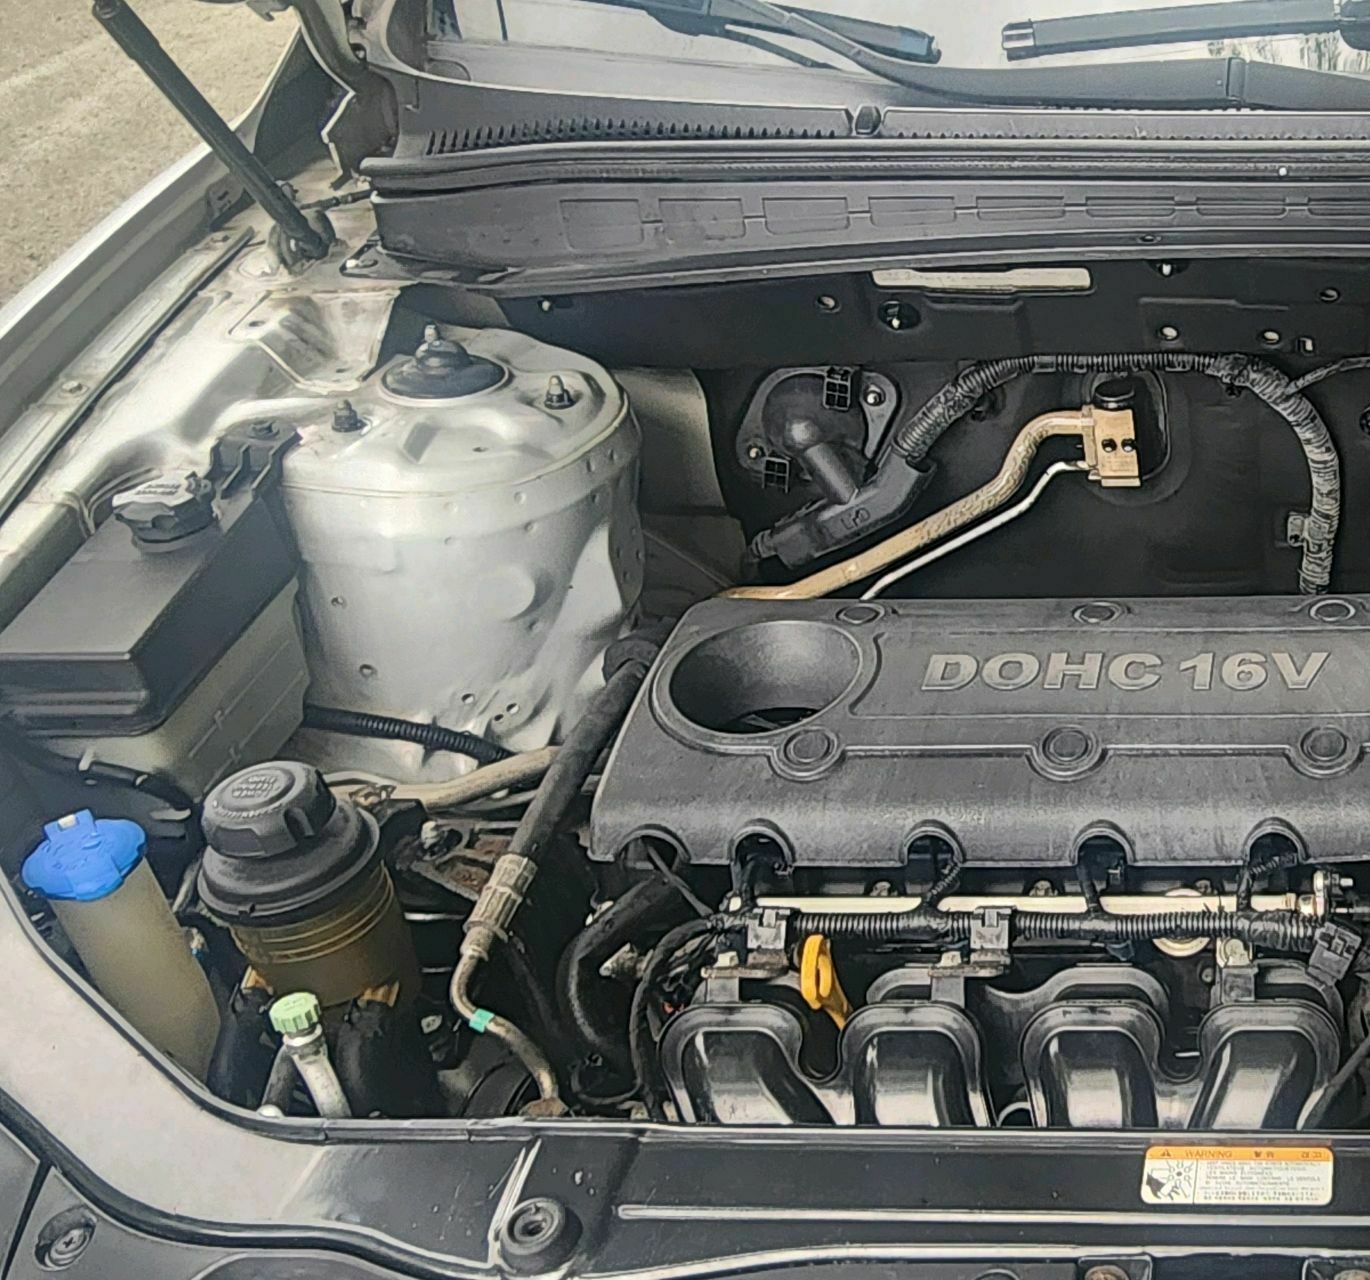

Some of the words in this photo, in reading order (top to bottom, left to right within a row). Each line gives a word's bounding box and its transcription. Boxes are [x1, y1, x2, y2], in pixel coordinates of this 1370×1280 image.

[920, 652, 1163, 691] DOHC
[1179, 652, 1331, 691] 16V
[1185, 1150, 1233, 1158] WARNING
